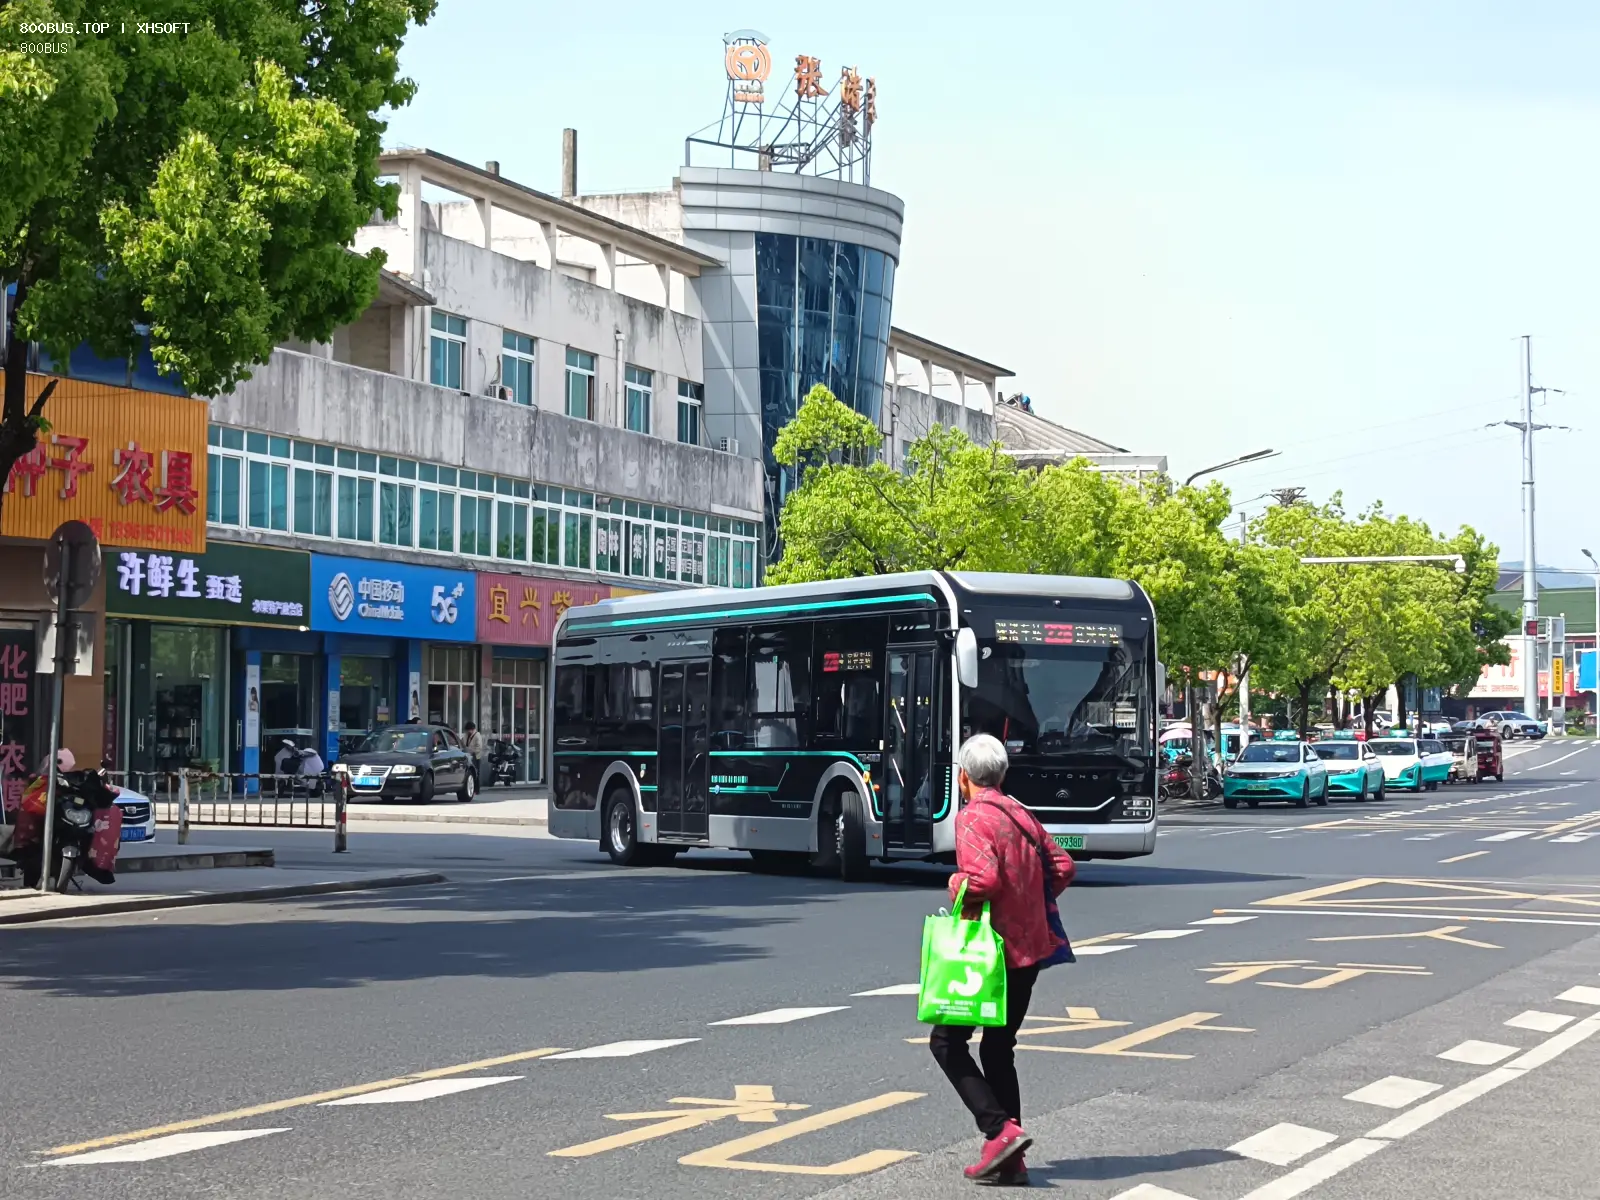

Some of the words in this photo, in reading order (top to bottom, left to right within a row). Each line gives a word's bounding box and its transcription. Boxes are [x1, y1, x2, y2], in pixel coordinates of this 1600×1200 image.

[110, 440, 199, 515] 农具
[117, 552, 201, 598] 许鲜生
[205, 574, 242, 604] 甄选
[357, 577, 405, 603] 中国移动
[487, 582, 599, 628] 宜兴紫
[0, 644, 28, 716] 化肥
[1028, 772, 1099, 780] YUTONG
